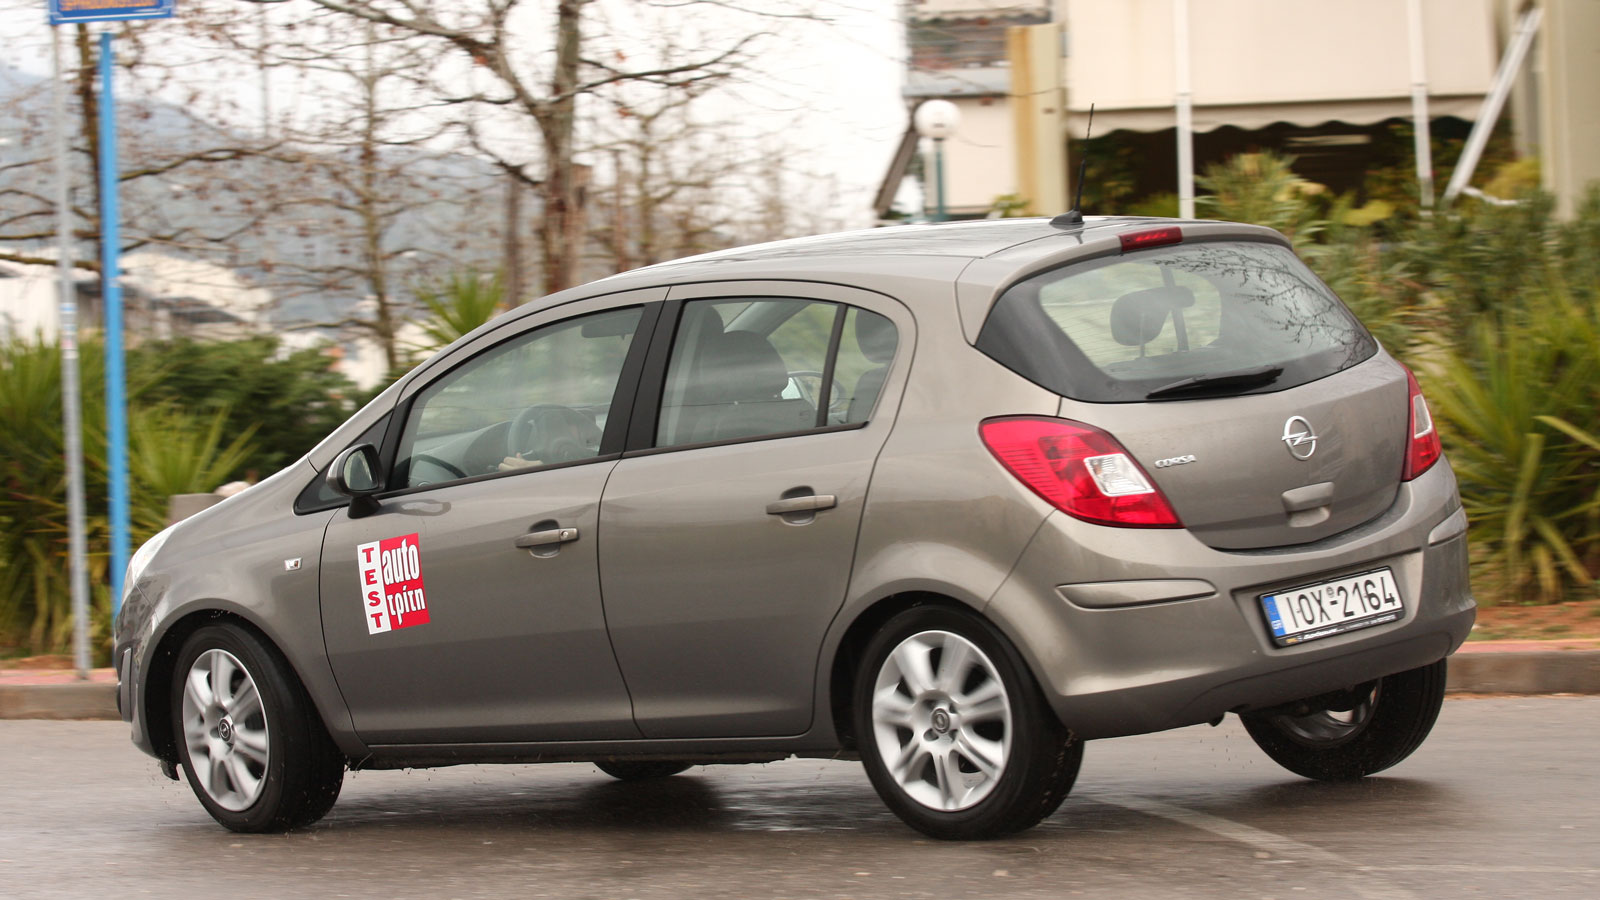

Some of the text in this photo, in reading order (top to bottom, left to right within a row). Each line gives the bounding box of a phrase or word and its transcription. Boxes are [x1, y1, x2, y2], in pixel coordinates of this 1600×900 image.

[1154, 454, 1196, 468] CORSA
[381, 538, 420, 585] auto
[362, 547, 383, 628] TEST
[387, 585, 426, 625] τρίτη
